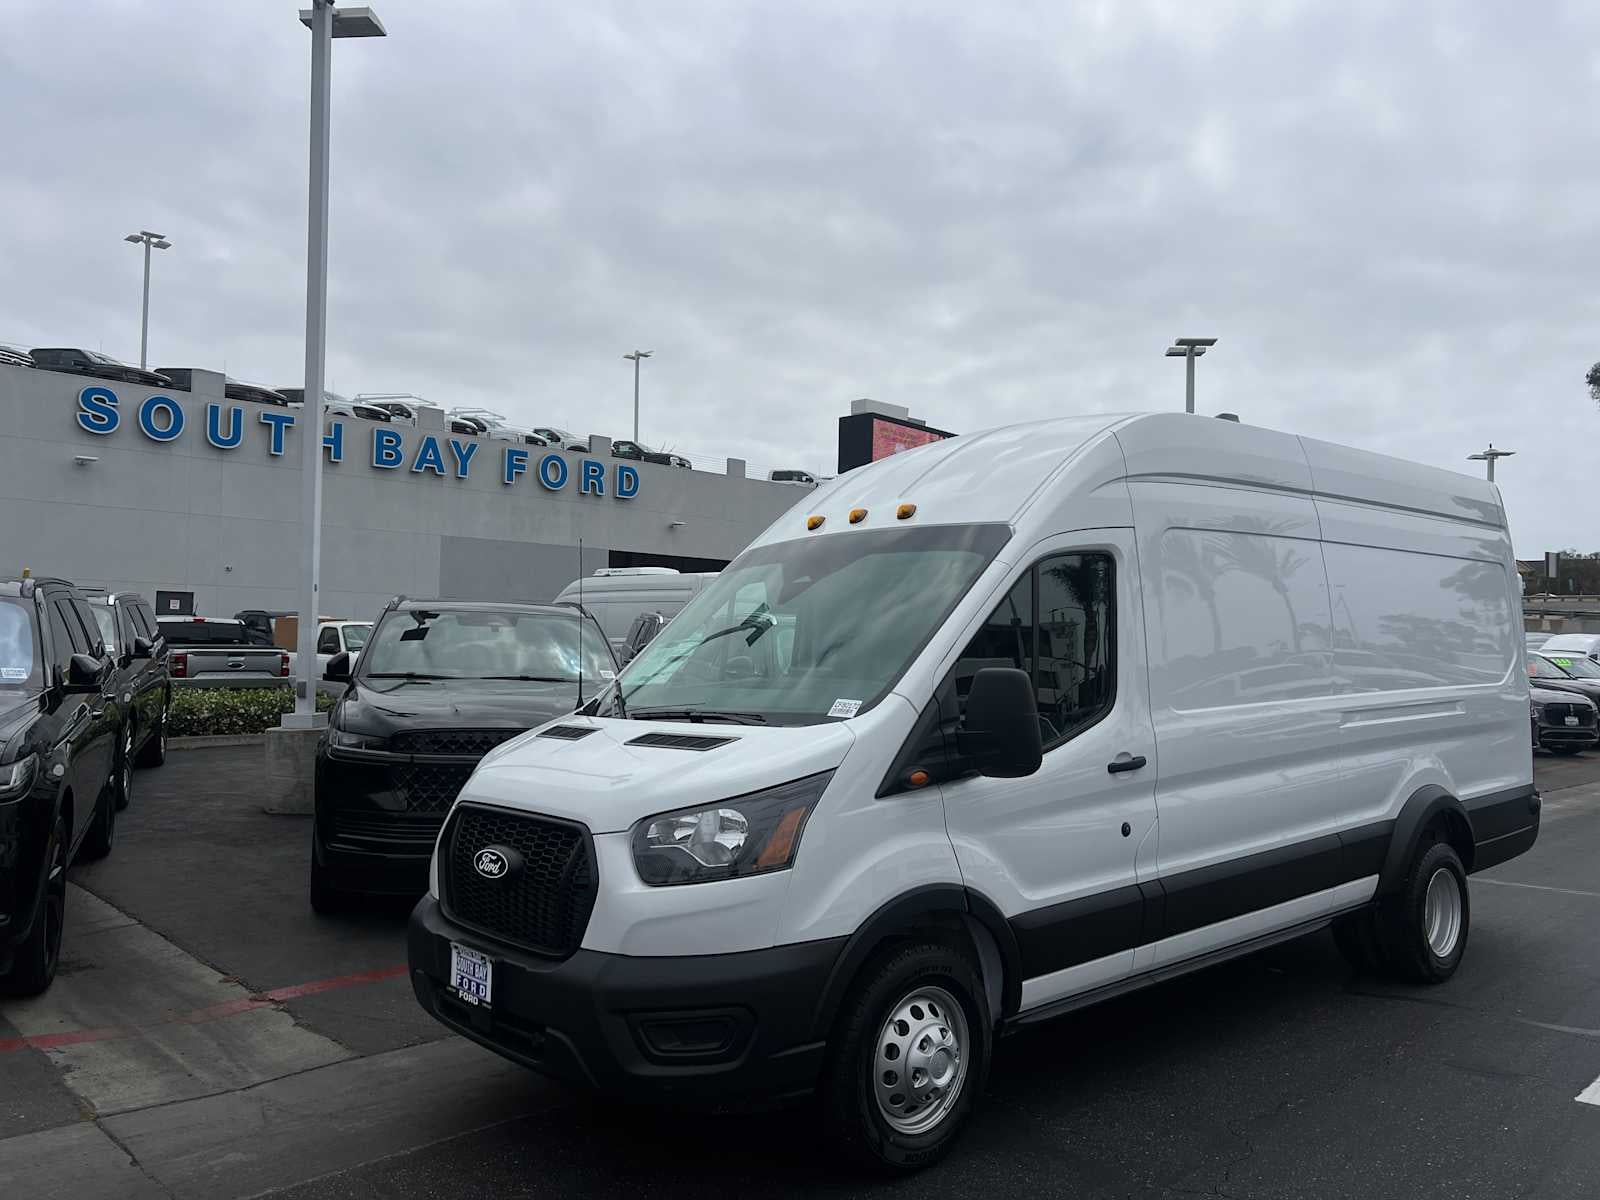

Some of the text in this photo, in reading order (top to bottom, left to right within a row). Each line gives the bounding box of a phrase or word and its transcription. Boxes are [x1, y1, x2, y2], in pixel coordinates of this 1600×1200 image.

[371, 427, 478, 479] BAY
[504, 448, 641, 499] FORD
[478, 852, 502, 875] Ford
[456, 957, 488, 982] SOUTH BAY
[456, 974, 486, 997] FORD
[458, 990, 479, 1006] FORD
